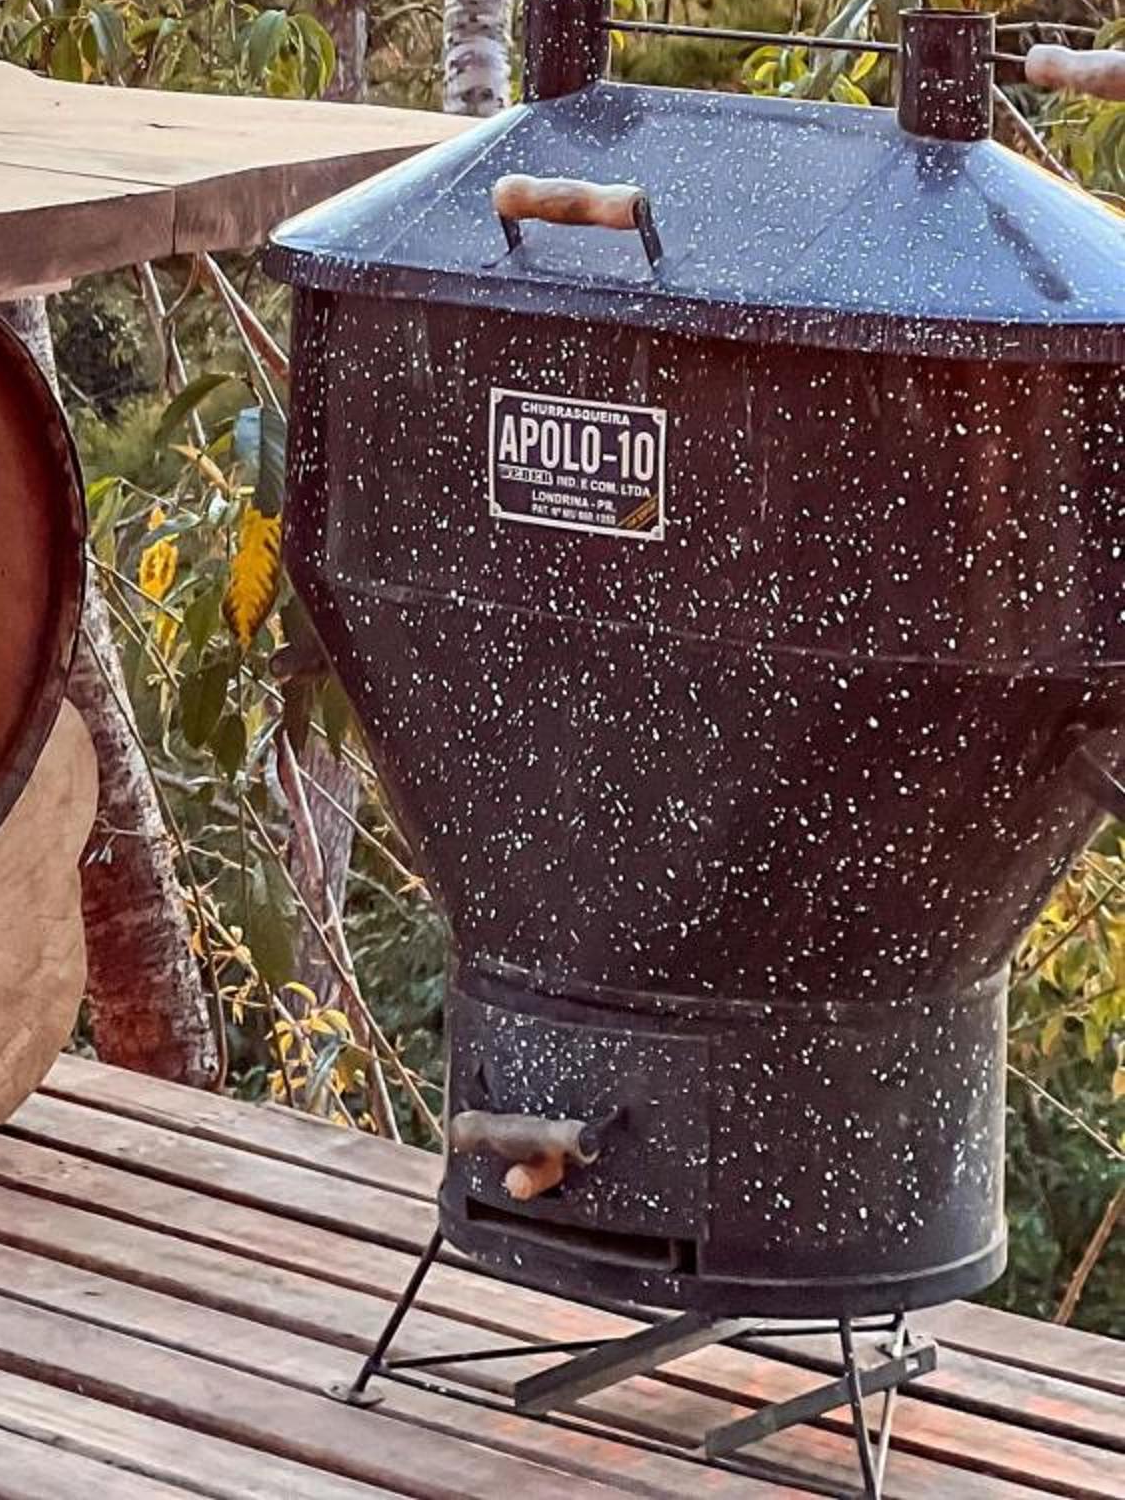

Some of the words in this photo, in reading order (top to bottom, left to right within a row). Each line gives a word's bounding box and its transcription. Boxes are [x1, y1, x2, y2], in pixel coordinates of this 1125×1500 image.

[521, 401, 631, 426] CHURRASQUEIRA
[498, 414, 655, 481] APOLO-10
[532, 490, 590, 508] LONDRINA
